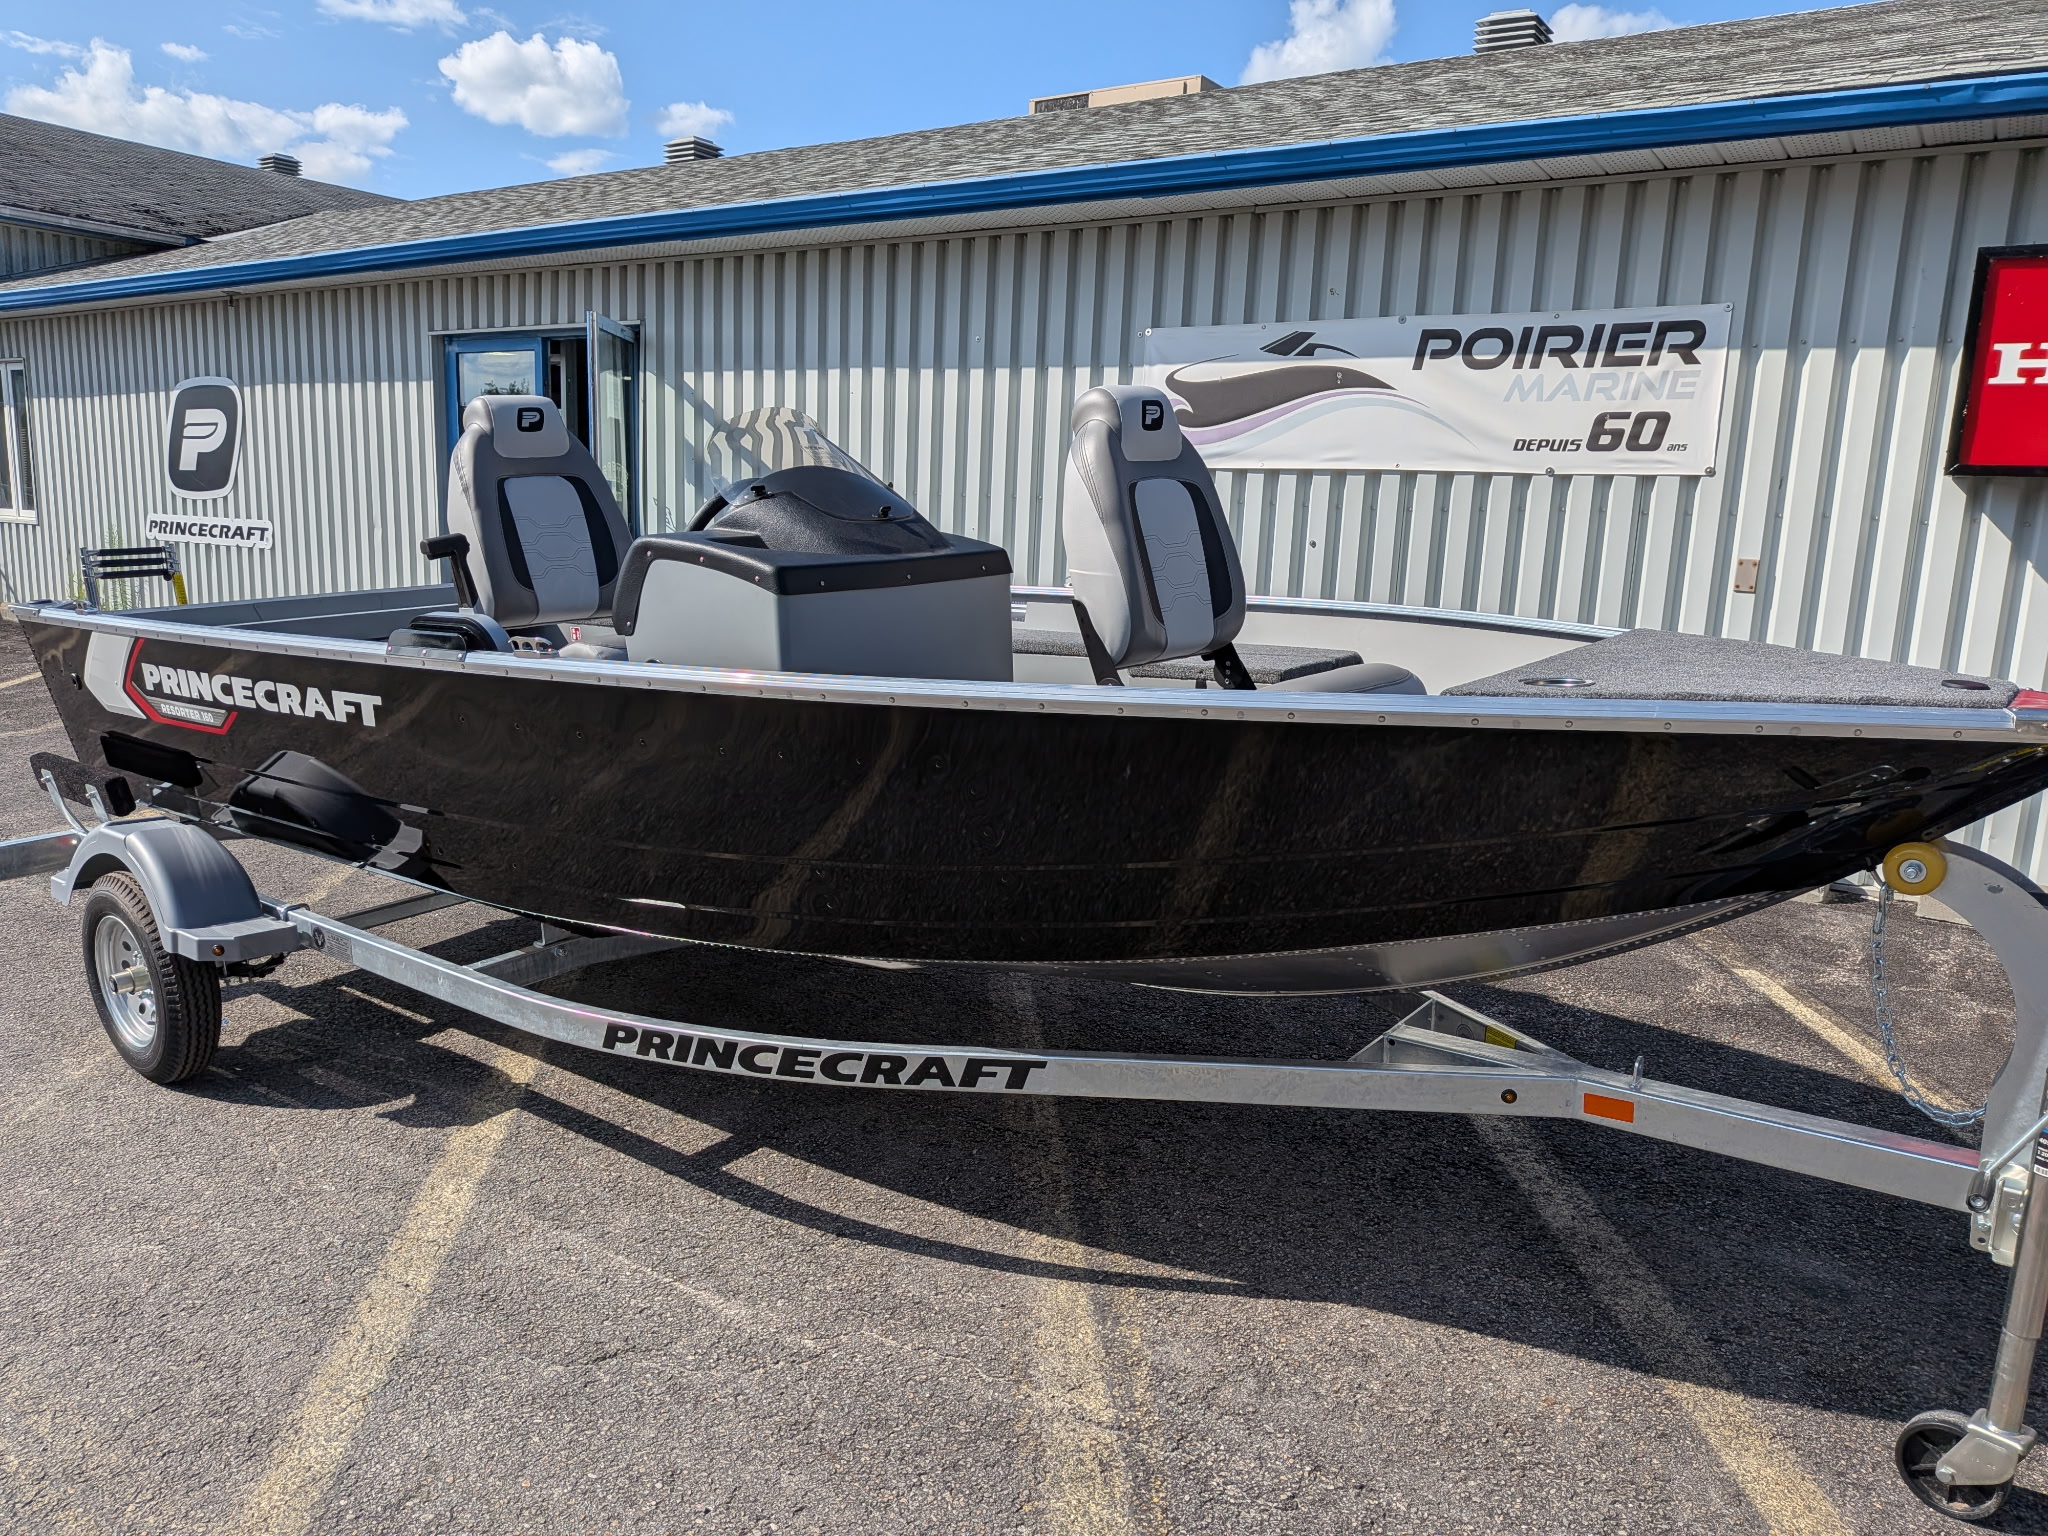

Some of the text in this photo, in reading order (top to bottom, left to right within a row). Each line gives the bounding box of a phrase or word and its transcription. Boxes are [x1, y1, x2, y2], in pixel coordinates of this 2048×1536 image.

[1412, 319, 1707, 370] POIRIER
[1503, 370, 1701, 402] MARINE
[1512, 411, 1688, 452] DEPUIS 60 ans
[148, 519, 269, 542] PRINCECRAFT
[141, 662, 382, 727] PRINCECRAFT
[161, 704, 201, 720] RESORTER
[602, 1023, 1047, 1090] PRINCECRAFT
